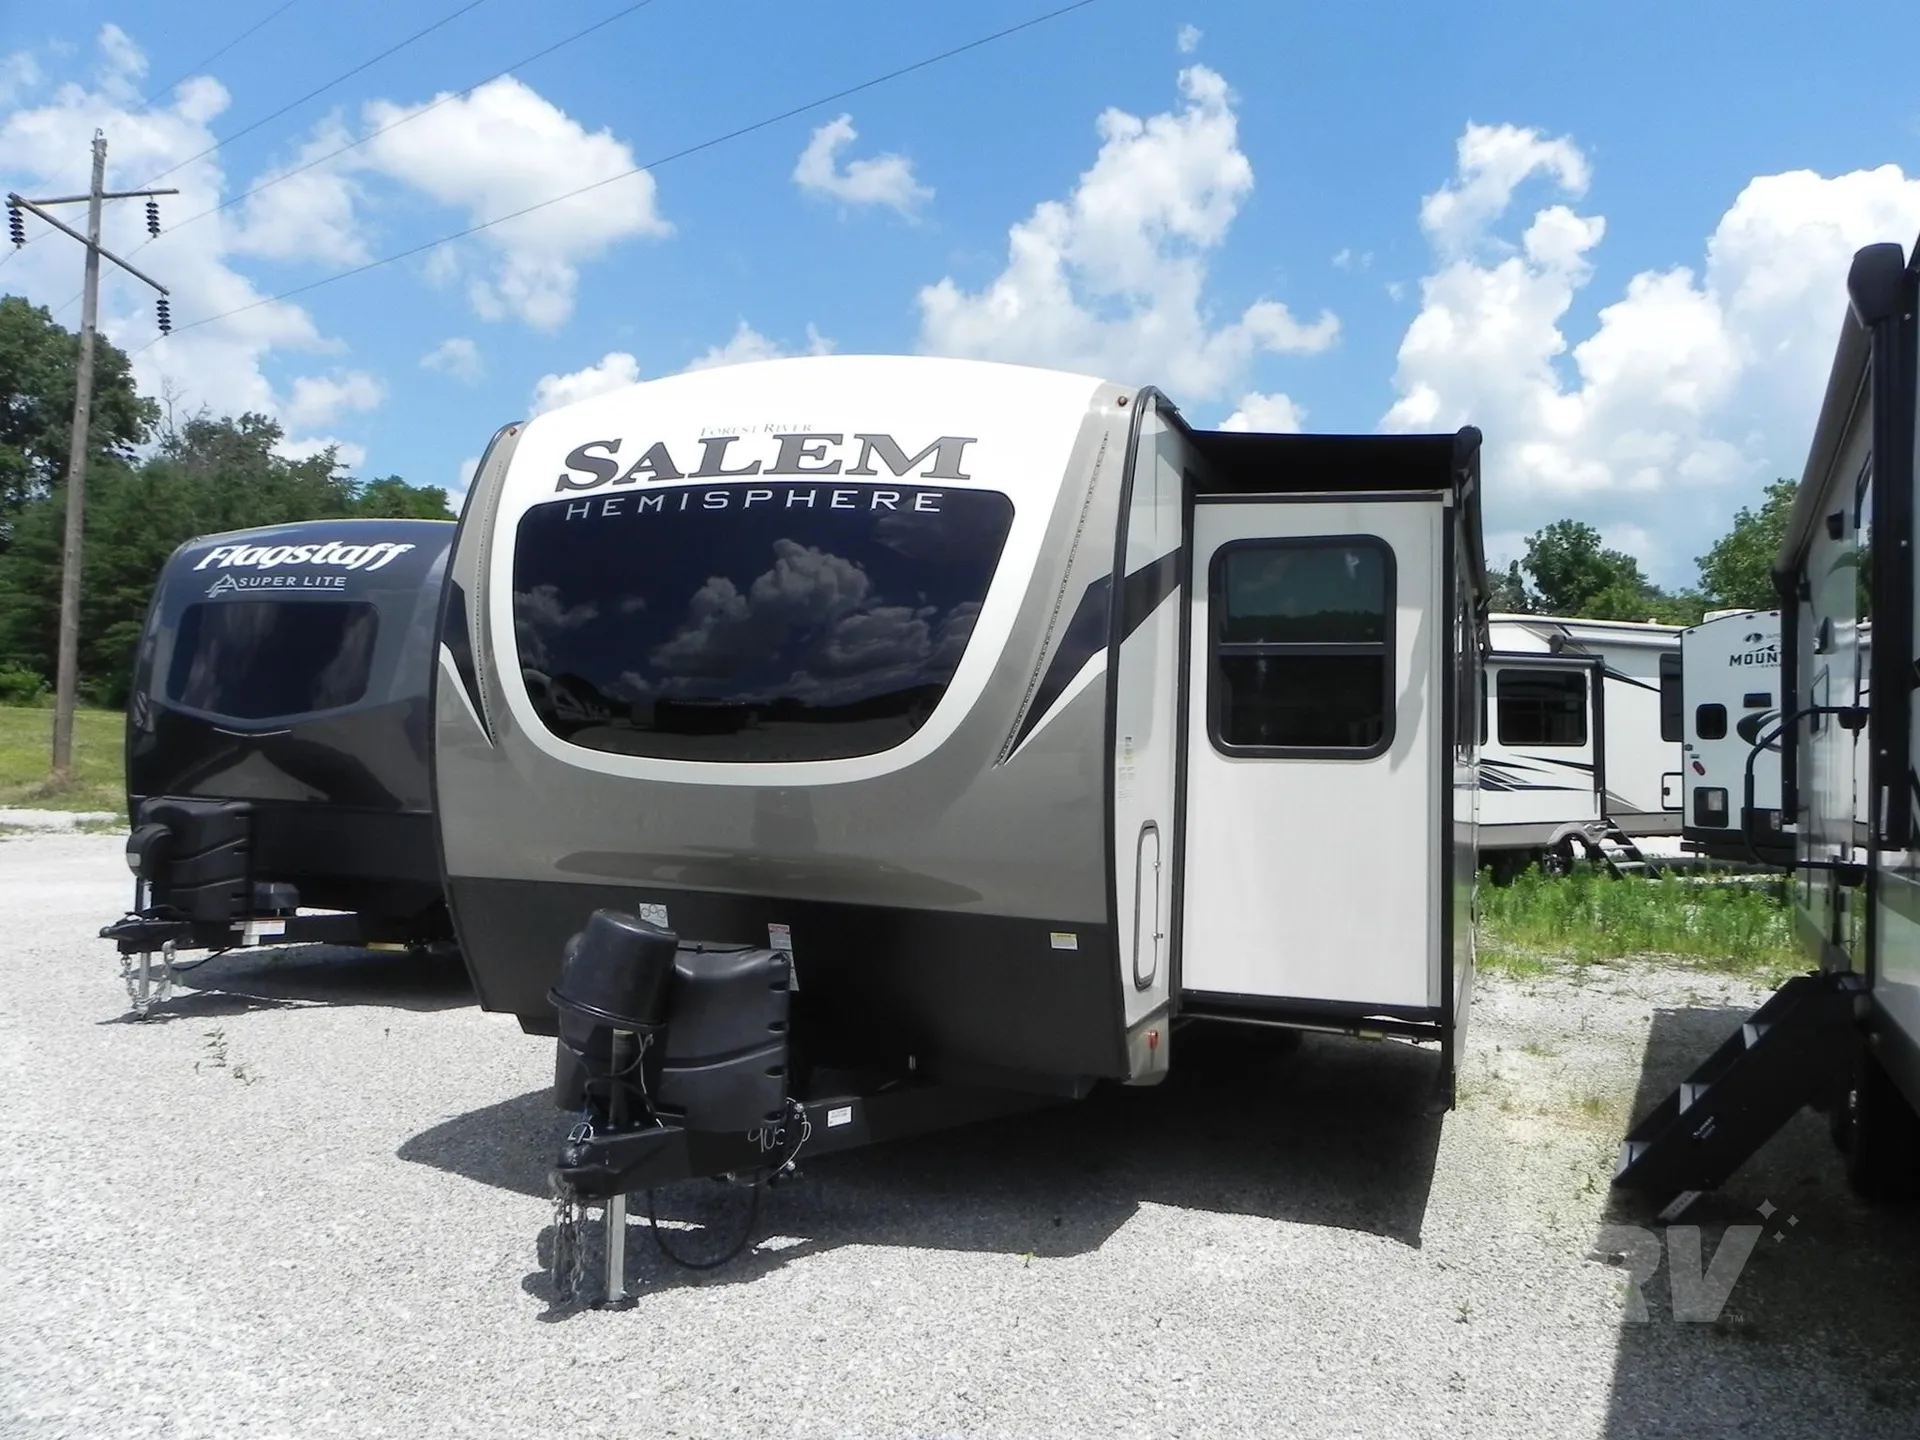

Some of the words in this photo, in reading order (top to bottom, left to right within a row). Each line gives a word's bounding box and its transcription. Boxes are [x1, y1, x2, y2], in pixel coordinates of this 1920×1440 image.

[764, 423, 812, 433] RIVER
[555, 433, 977, 492] SALEM
[565, 489, 944, 520] HEMISPHERE
[193, 541, 416, 571] Flagstaff
[239, 576, 297, 587] SUPER
[303, 576, 346, 587] LITE
[1729, 652, 1781, 667] MOUN
